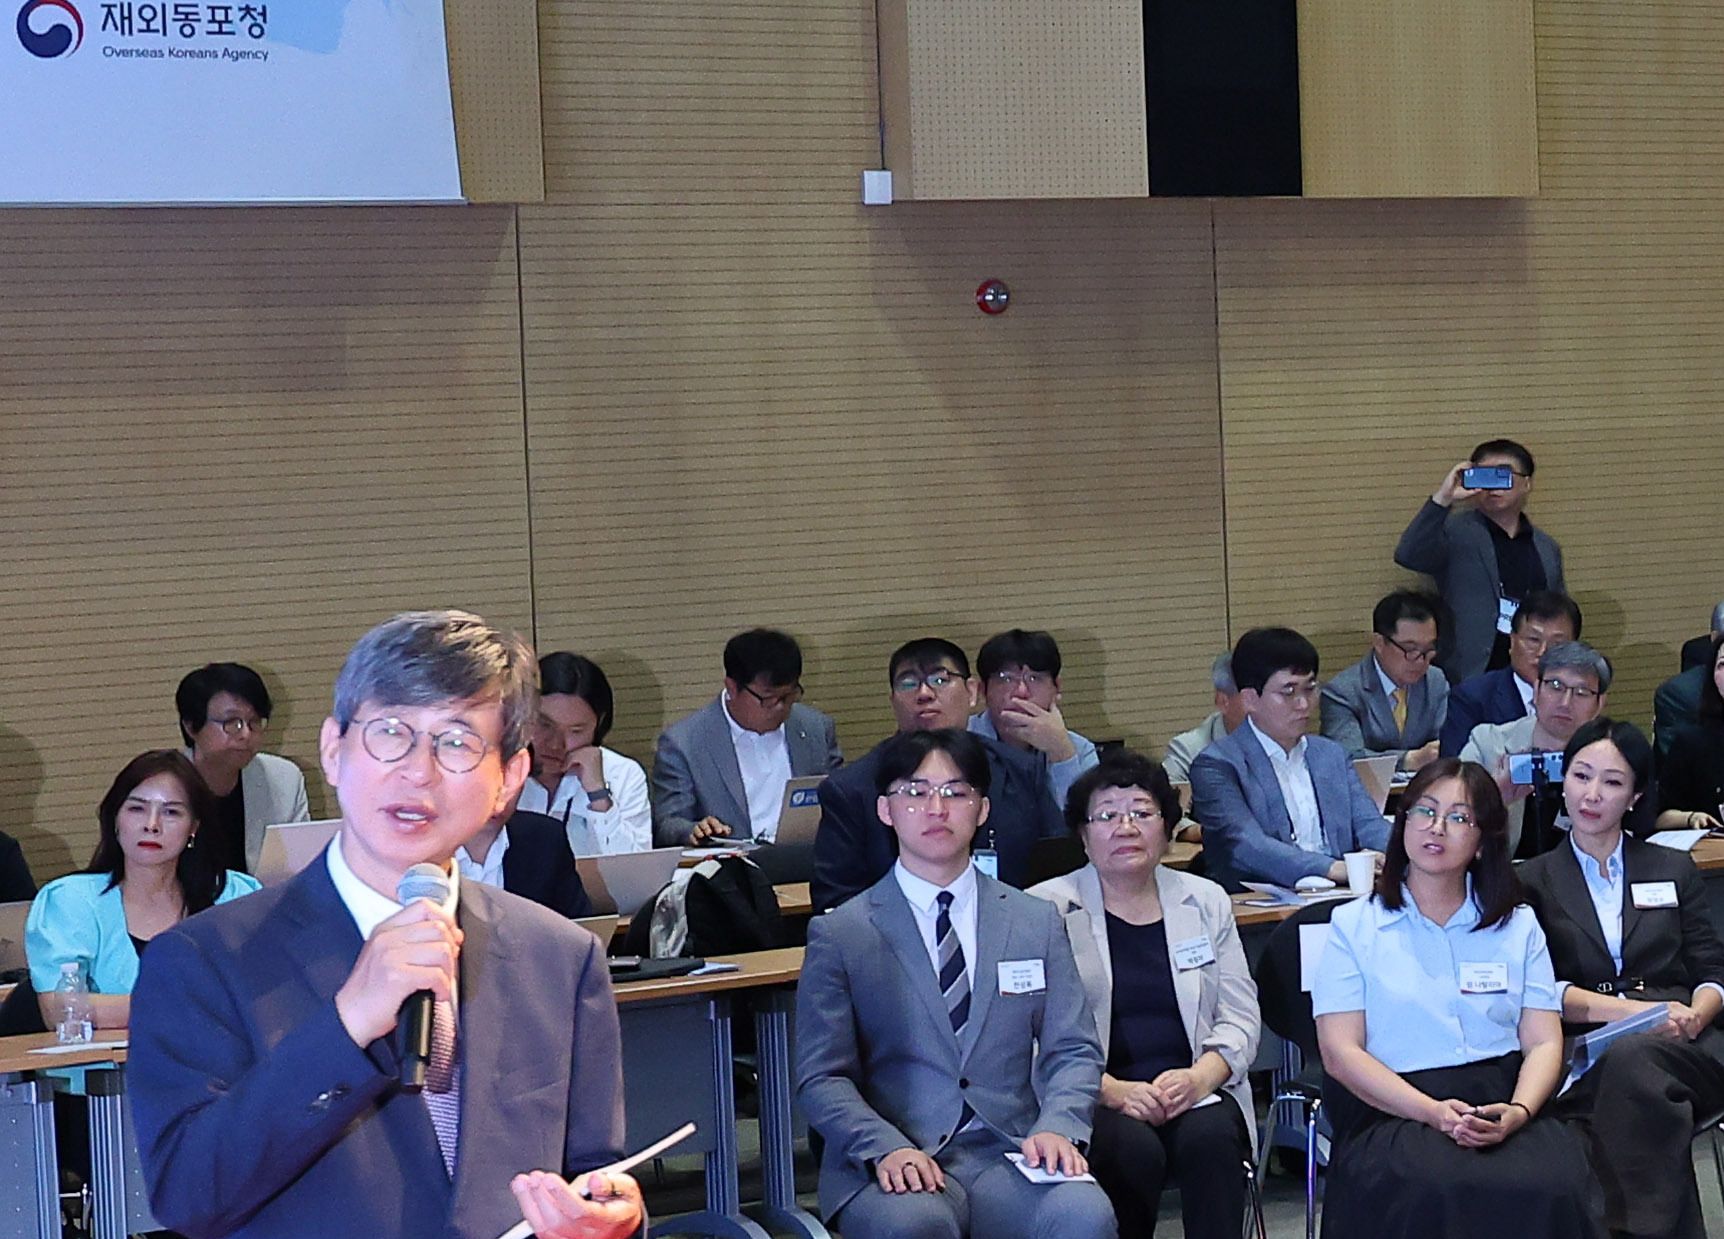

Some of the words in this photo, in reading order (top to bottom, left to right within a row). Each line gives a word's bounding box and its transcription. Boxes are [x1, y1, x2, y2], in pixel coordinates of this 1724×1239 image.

[101, 3, 268, 39] 재외동포청
[102, 46, 165, 60] Overseas
[168, 46, 219, 60] Koreans
[222, 47, 269, 61] Agency
